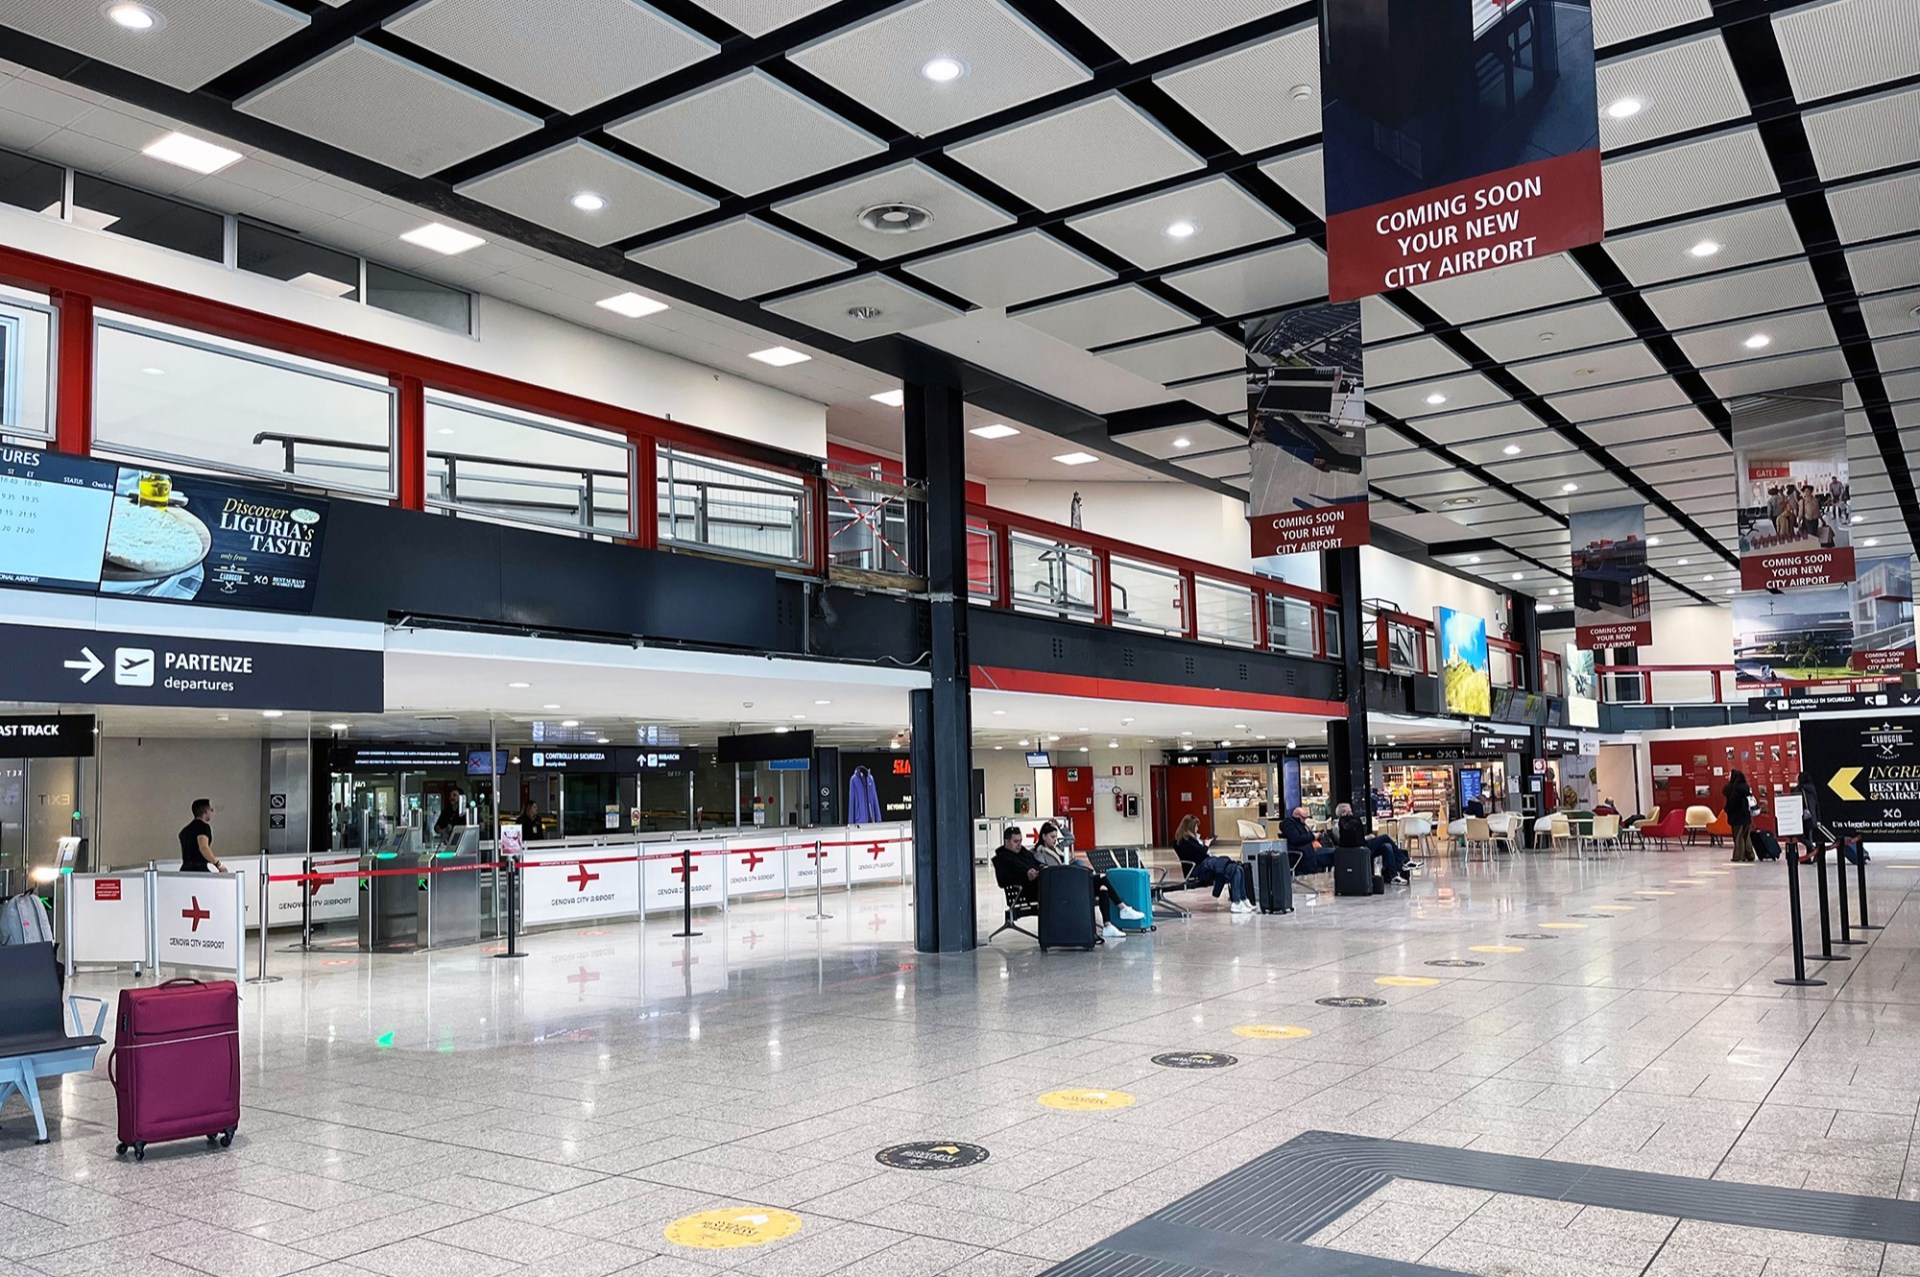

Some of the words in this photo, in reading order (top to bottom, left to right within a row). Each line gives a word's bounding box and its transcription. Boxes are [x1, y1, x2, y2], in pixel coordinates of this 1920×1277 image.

[1376, 194, 1467, 235] COMING
[1474, 175, 1541, 211] SOON
[1397, 224, 1459, 257] YOUR
[1466, 209, 1520, 241] NEW
[1384, 260, 1432, 289] CITY
[1437, 236, 1537, 278] AIRPORT
[1755, 469, 1772, 478] GATE
[1773, 468, 1778, 476] 2
[63, 476, 84, 486] STATUS
[223, 498, 289, 520] Discover
[220, 512, 314, 541] LIGURIA's
[1272, 514, 1313, 530] COMING
[1315, 510, 1345, 524] SOON
[1282, 528, 1310, 541] YOUR
[1311, 524, 1335, 537] NEW
[250, 534, 312, 558] TASTE
[1276, 543, 1298, 556] CITY
[1300, 537, 1343, 553] AIRPORT
[1762, 556, 1801, 568] COMING
[1804, 553, 1832, 564] SOON
[1771, 566, 1798, 577] YOUR
[1800, 564, 1824, 575] NEW
[1766, 579, 1787, 590] CITY
[1789, 575, 1831, 587] AIRPORT
[1590, 627, 1617, 636] COMING
[1618, 625, 1637, 633] SOON
[1596, 634, 1614, 642] YOUR
[1592, 642, 1607, 650] CITY
[1608, 640, 1636, 649] AIRPORT
[164, 651, 253, 674] PARTENZE
[163, 676, 235, 692] departures
[1790, 697, 1819, 705] CONTROLLI
[21, 724, 60, 736] TRACK
[1871, 734, 1903, 744] CARUGGIO
[545, 752, 573, 761] CONTROLLI
[573, 752, 580, 761] DI
[580, 752, 606, 761] SICUREZZA
[1844, 820, 1870, 829] viaggio
[1871, 820, 1883, 828] nei
[1884, 819, 1907, 829] sapori
[758, 873, 775, 881] AIRPORT
[657, 887, 679, 896] GENOVA
[691, 884, 712, 893] AIRPORT
[278, 901, 303, 910] GENOV
[312, 899, 323, 907] ITY
[323, 897, 352, 906] AIRPORT
[551, 897, 576, 906] GENOVA
[576, 895, 590, 904] CITY
[590, 893, 616, 903] AIRPORT
[169, 937, 190, 947] GENOVA
[190, 938, 202, 948] CITY
[202, 940, 225, 950] AIRPORT
